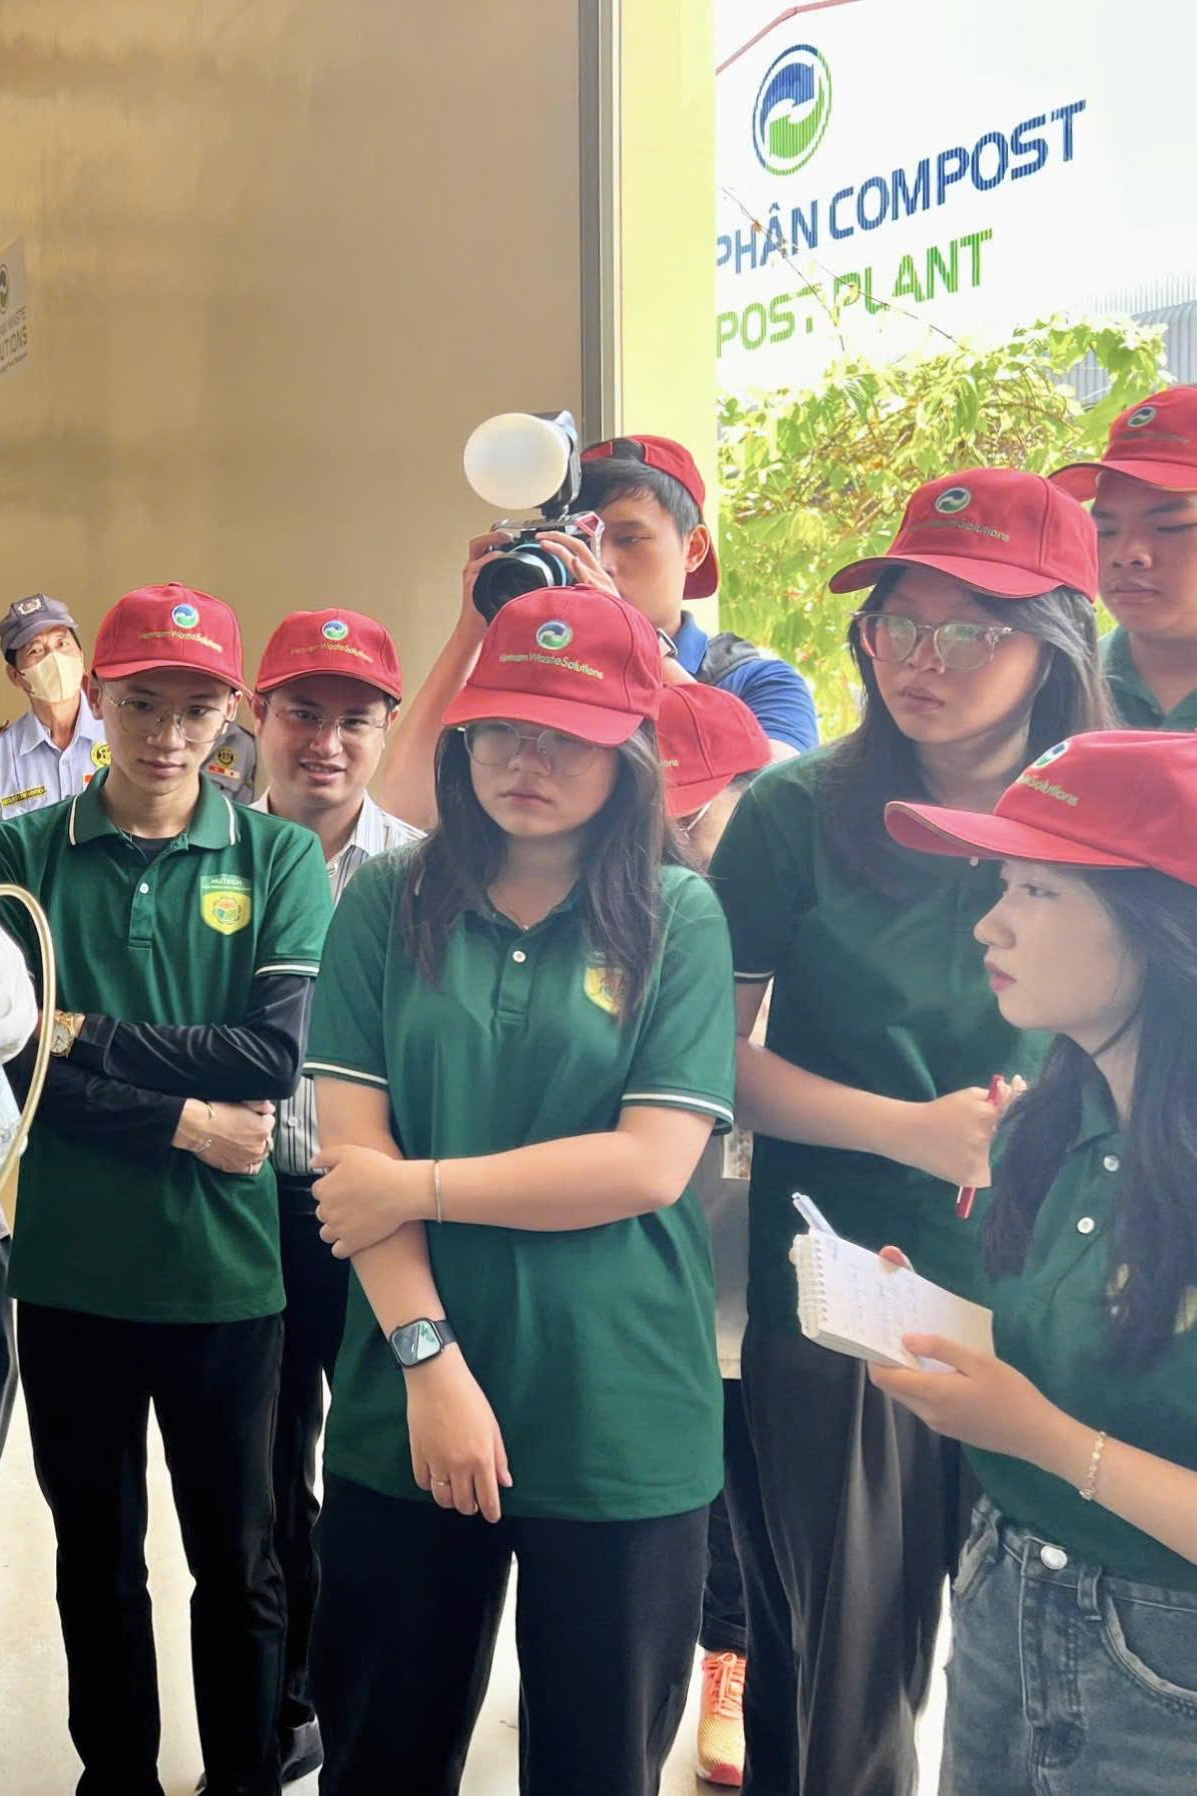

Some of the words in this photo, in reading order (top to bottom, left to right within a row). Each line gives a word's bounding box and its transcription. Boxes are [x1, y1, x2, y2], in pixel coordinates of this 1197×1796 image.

[716, 199, 818, 275] PHÂN
[829, 99, 1086, 240] COMPOST
[833, 228, 993, 316] PLANT
